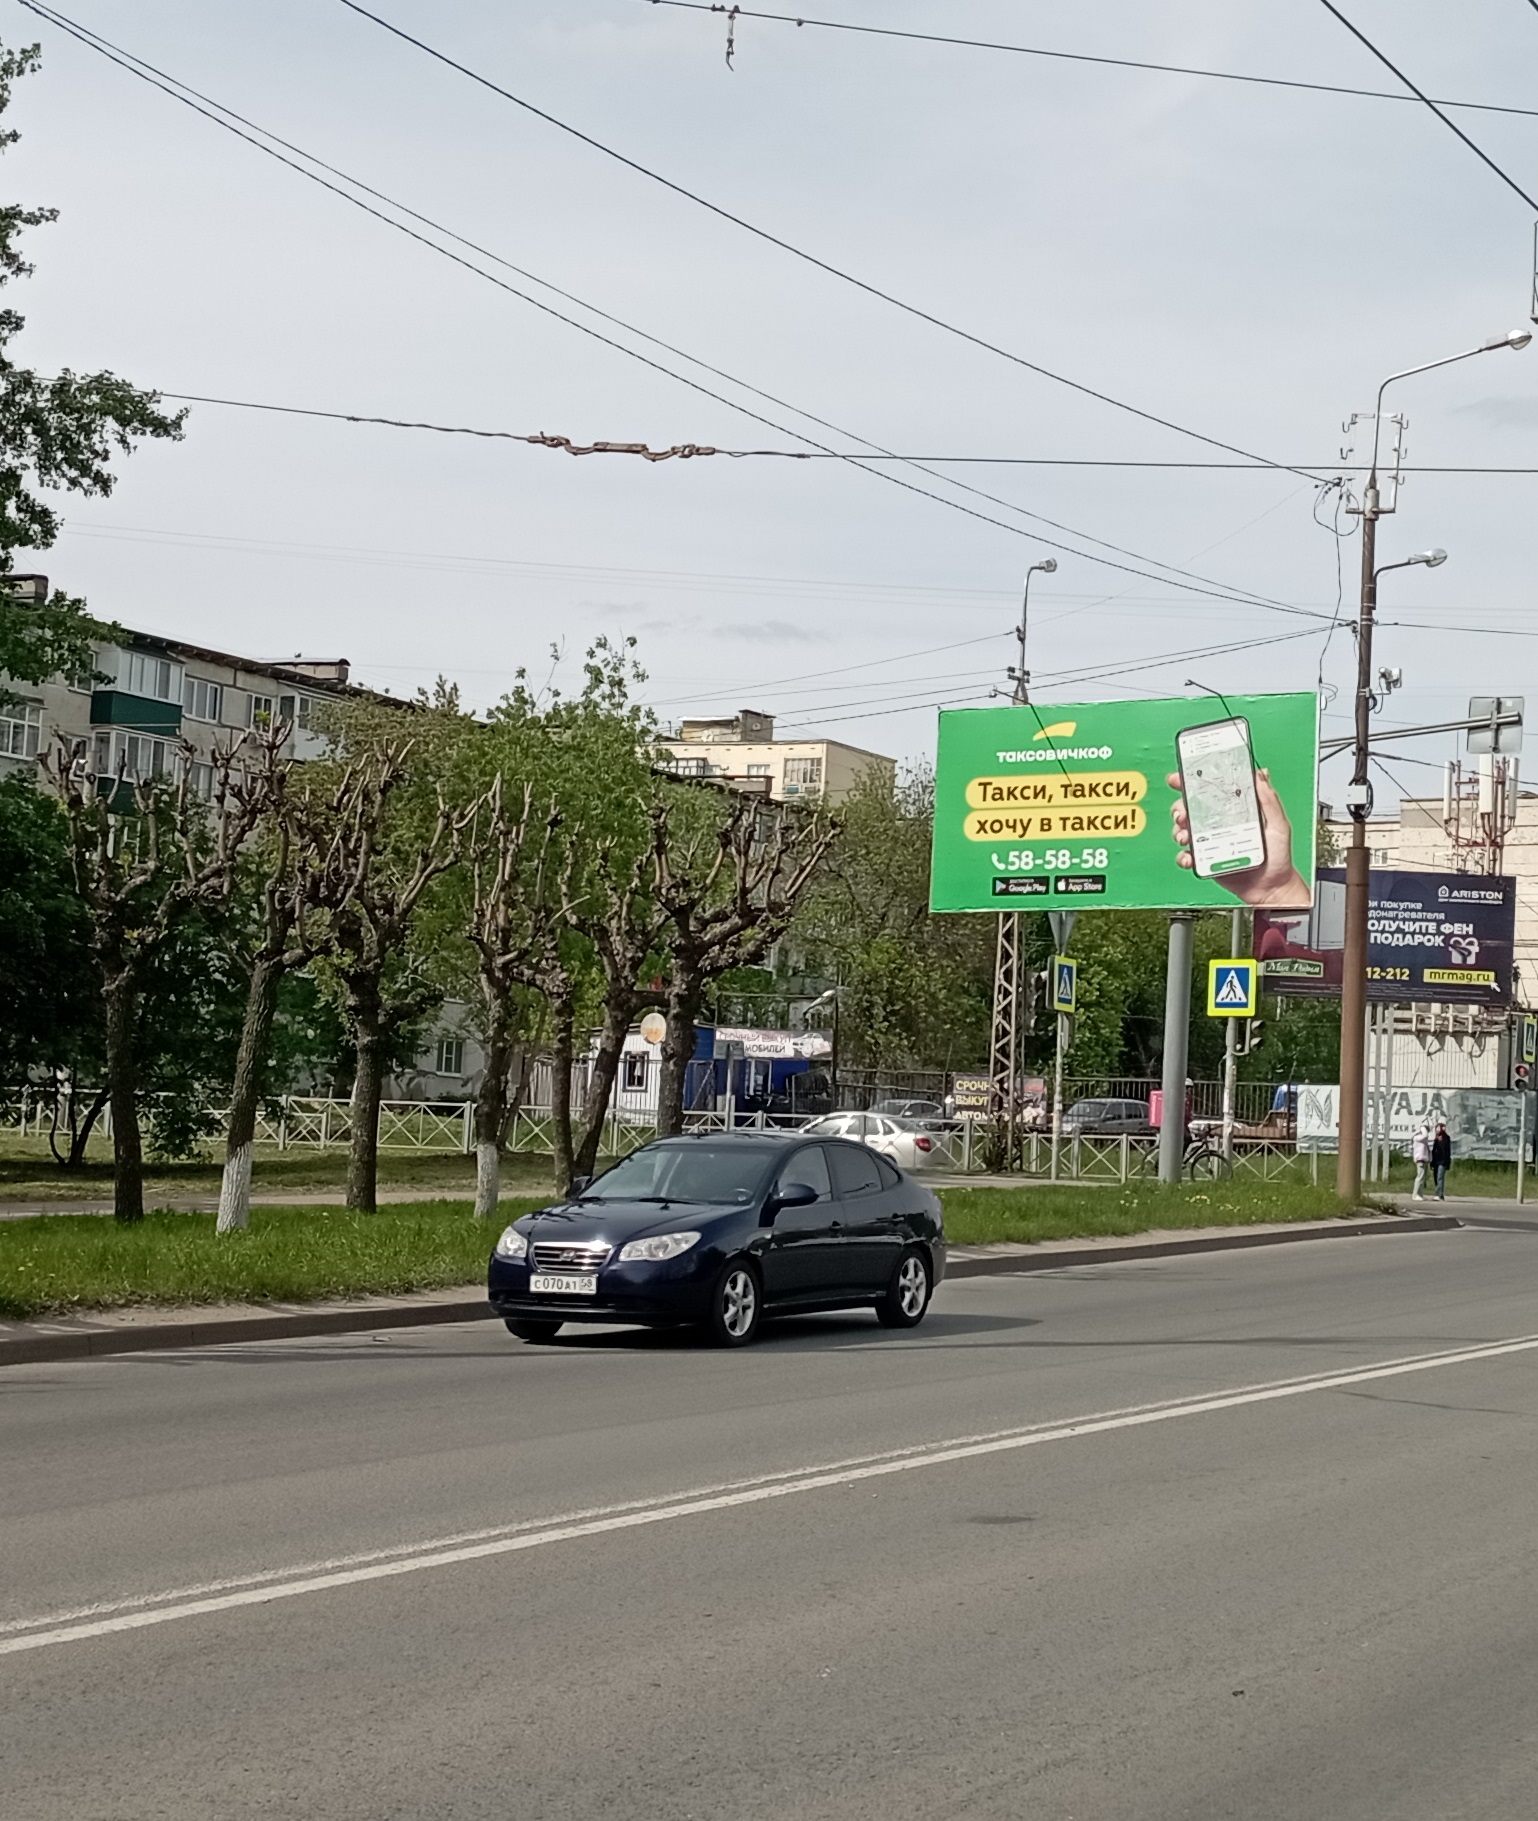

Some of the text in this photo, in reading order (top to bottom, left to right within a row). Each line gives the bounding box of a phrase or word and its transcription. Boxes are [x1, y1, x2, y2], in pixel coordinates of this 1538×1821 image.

[978, 781, 1138, 803] Такси, такси,
[975, 809, 1136, 839] хочу в такси!
[1007, 848, 1109, 870] 58-58-58
[1068, 883, 1082, 892] App
[1083, 882, 1102, 891] Store
[1451, 890, 1503, 899] ARISTON
[1381, 901, 1423, 910] покупке
[1368, 910, 1445, 920] донагревателя
[1367, 919, 1474, 935] ОЛУЧИТЕ ФЕН
[1369, 932, 1445, 947] ПОДАРОК
[1365, 967, 1490, 983] 12-212 mrmag.ru
